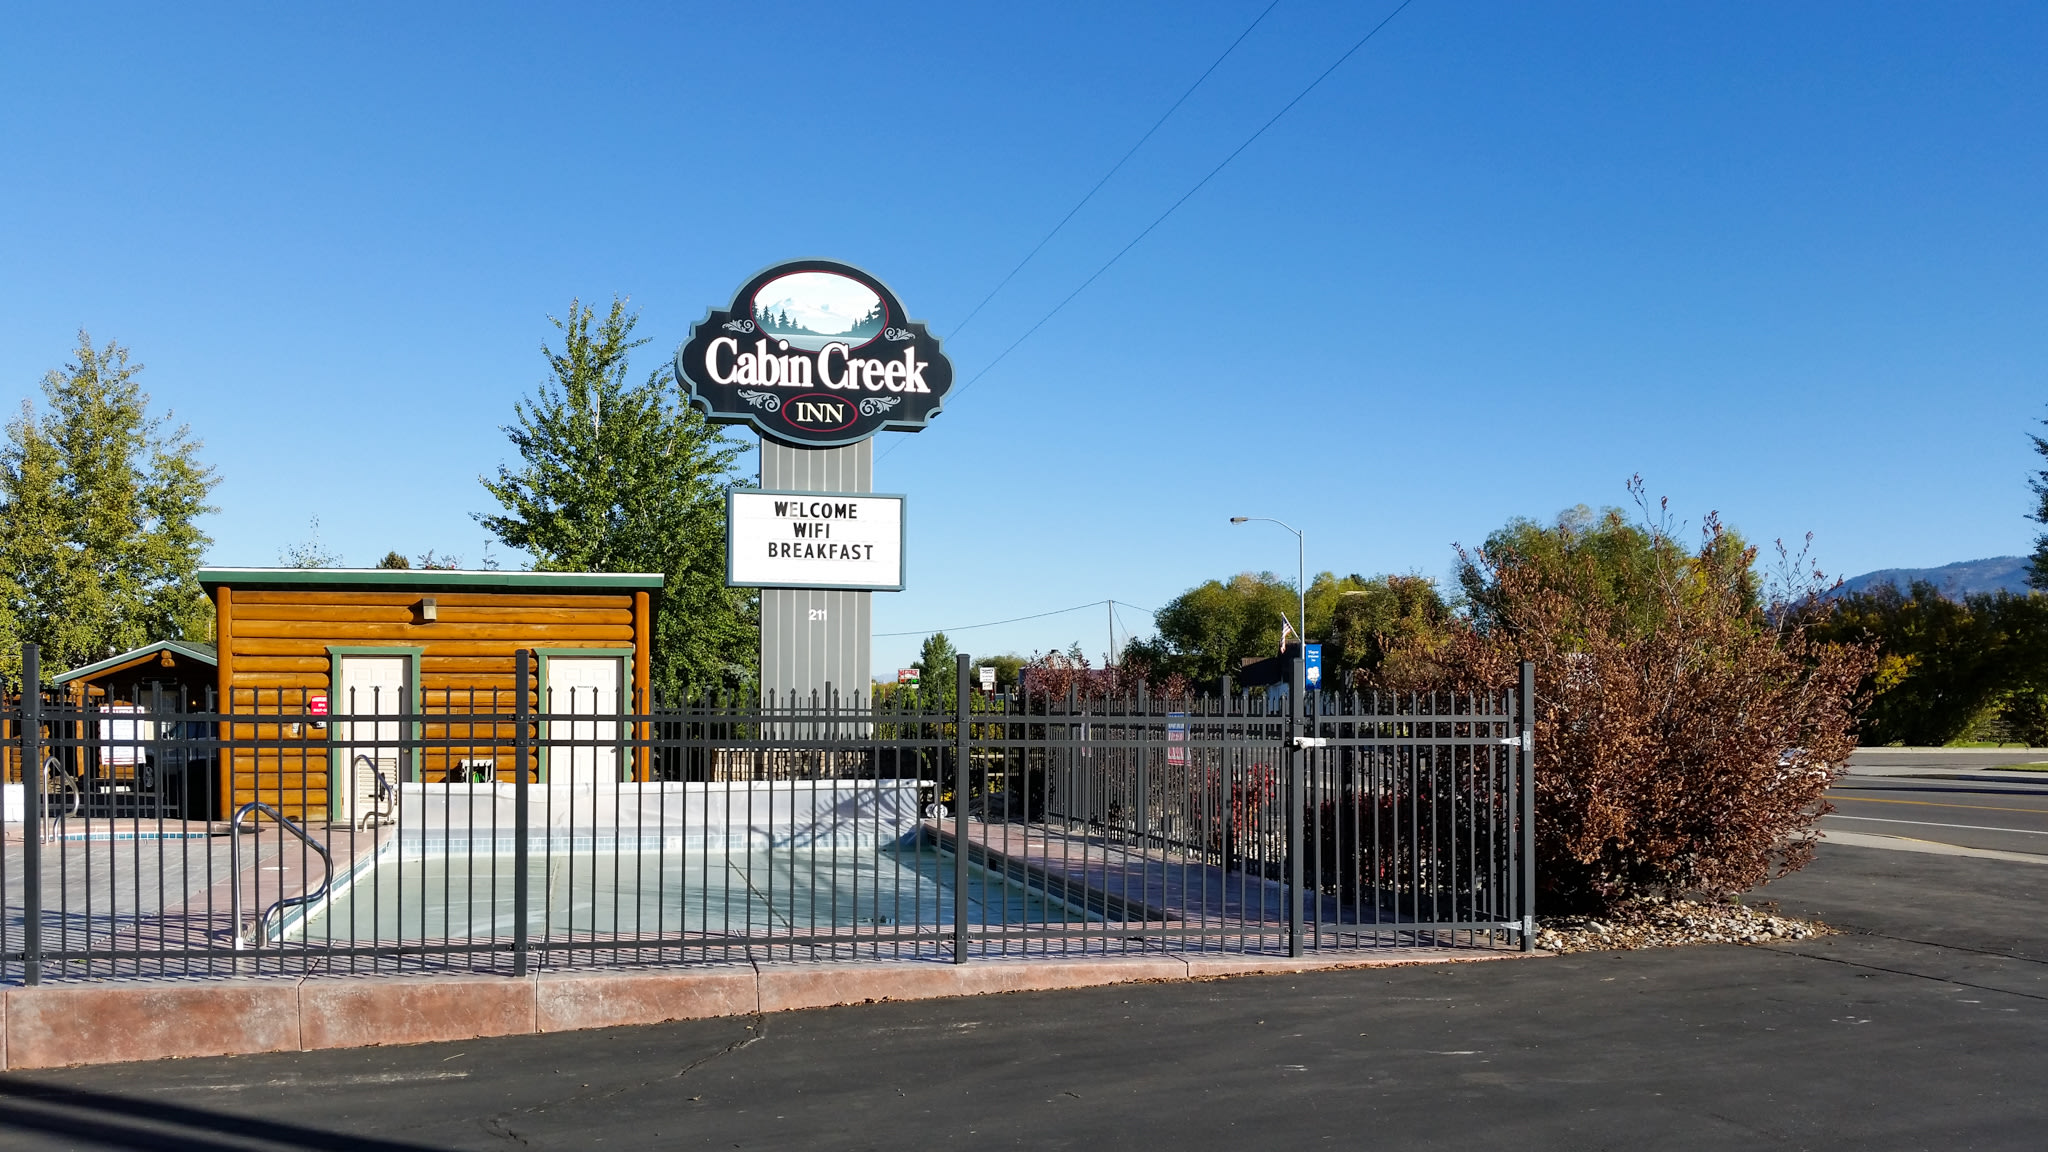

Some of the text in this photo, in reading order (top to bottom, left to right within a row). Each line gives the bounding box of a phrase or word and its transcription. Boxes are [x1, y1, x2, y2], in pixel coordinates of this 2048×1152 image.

[704, 336, 931, 394] Cabin Creek
[796, 402, 845, 424] INN
[774, 501, 858, 519] WELCOME
[793, 522, 831, 539] WIFI
[768, 542, 874, 560] BREAKFAST
[808, 608, 828, 621] 211
